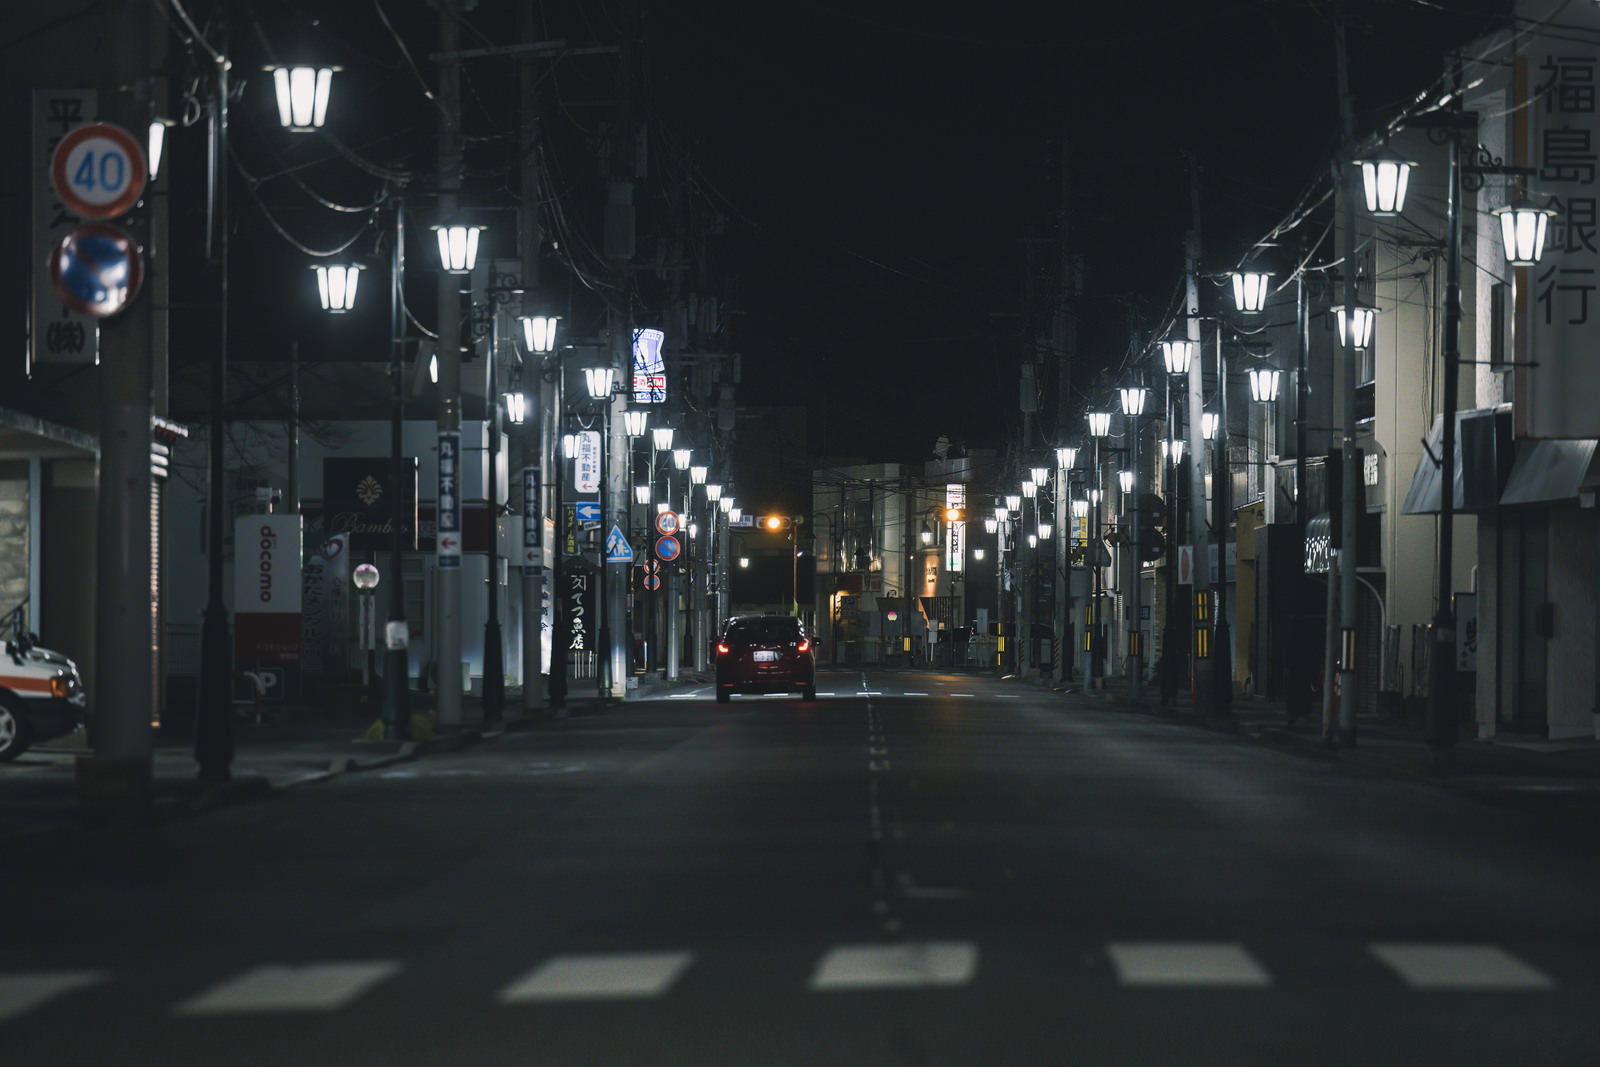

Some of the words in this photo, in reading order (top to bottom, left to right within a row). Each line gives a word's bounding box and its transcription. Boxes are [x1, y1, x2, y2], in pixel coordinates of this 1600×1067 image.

[74, 151, 124, 191] 40
[1536, 55, 1597, 326] 福島銀行
[662, 517, 675, 529] 40
[260, 525, 277, 603] docomo
